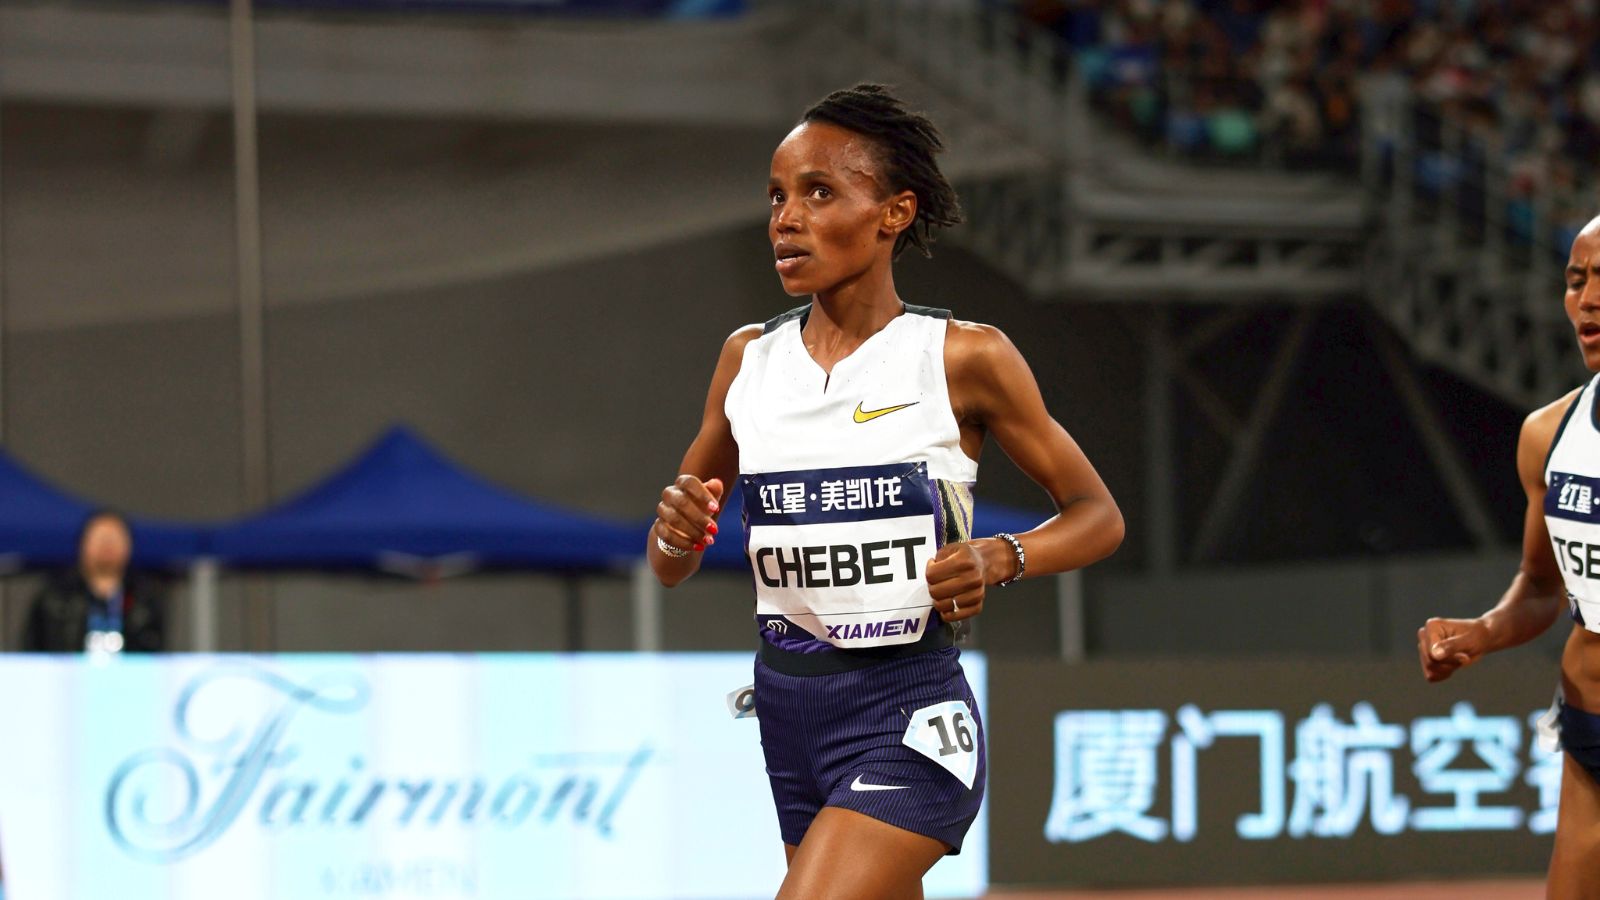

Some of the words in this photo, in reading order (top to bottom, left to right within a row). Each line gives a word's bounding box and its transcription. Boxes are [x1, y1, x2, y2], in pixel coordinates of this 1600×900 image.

[759, 476, 903, 515] 红星·美凯龙
[756, 536, 926, 588] CHEBET
[825, 618, 920, 640] XIAMEN
[928, 712, 974, 757] 16
[104, 659, 660, 864] Fairmont
